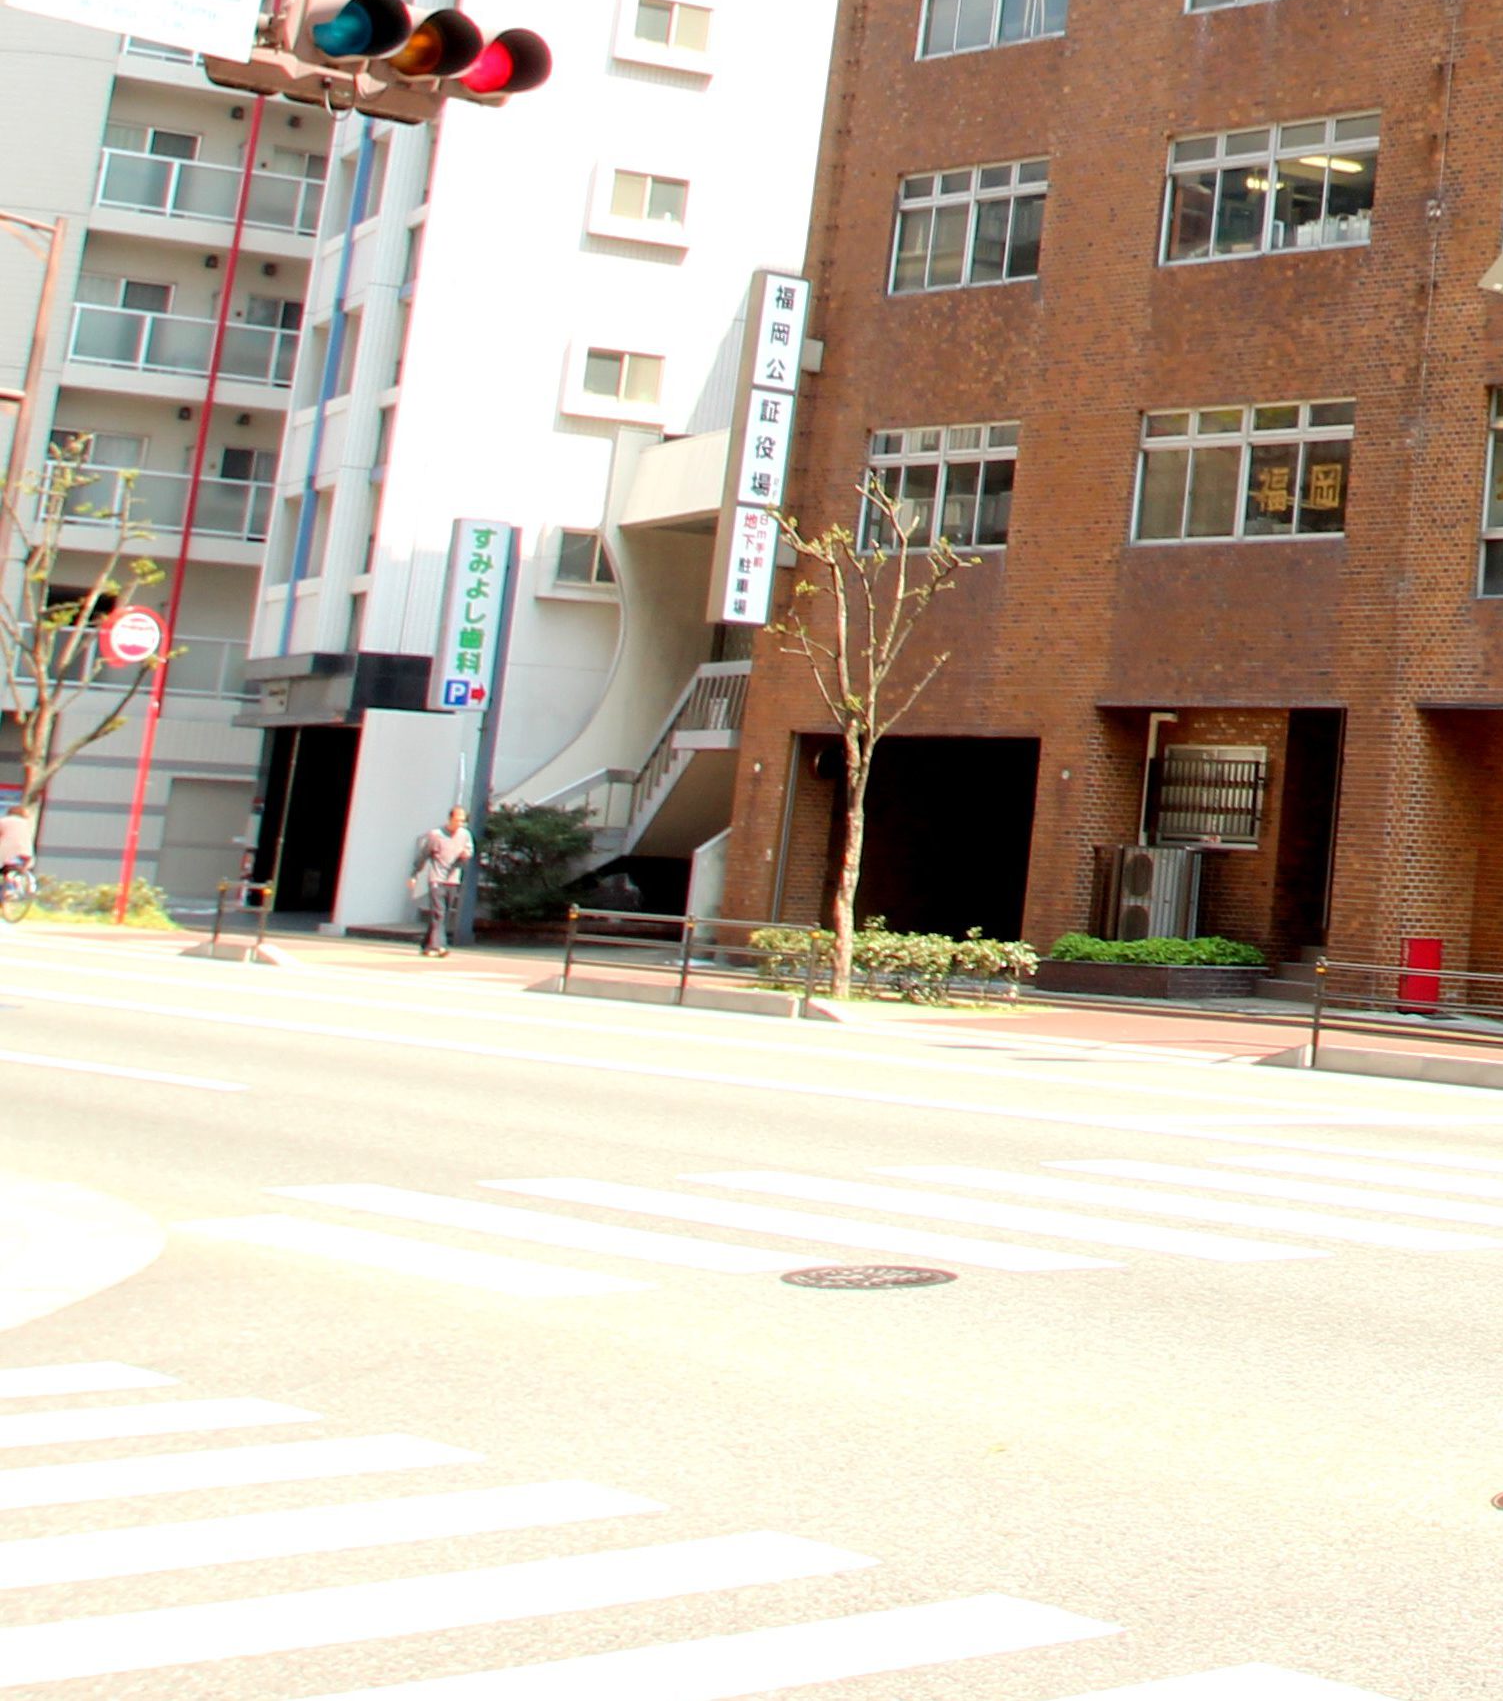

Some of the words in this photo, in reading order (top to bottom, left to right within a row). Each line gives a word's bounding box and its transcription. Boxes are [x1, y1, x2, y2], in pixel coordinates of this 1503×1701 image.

[750, 284, 796, 498] 福岡公証役場
[455, 527, 498, 675] すみよし歯科
[733, 512, 759, 616] 地下駐車場
